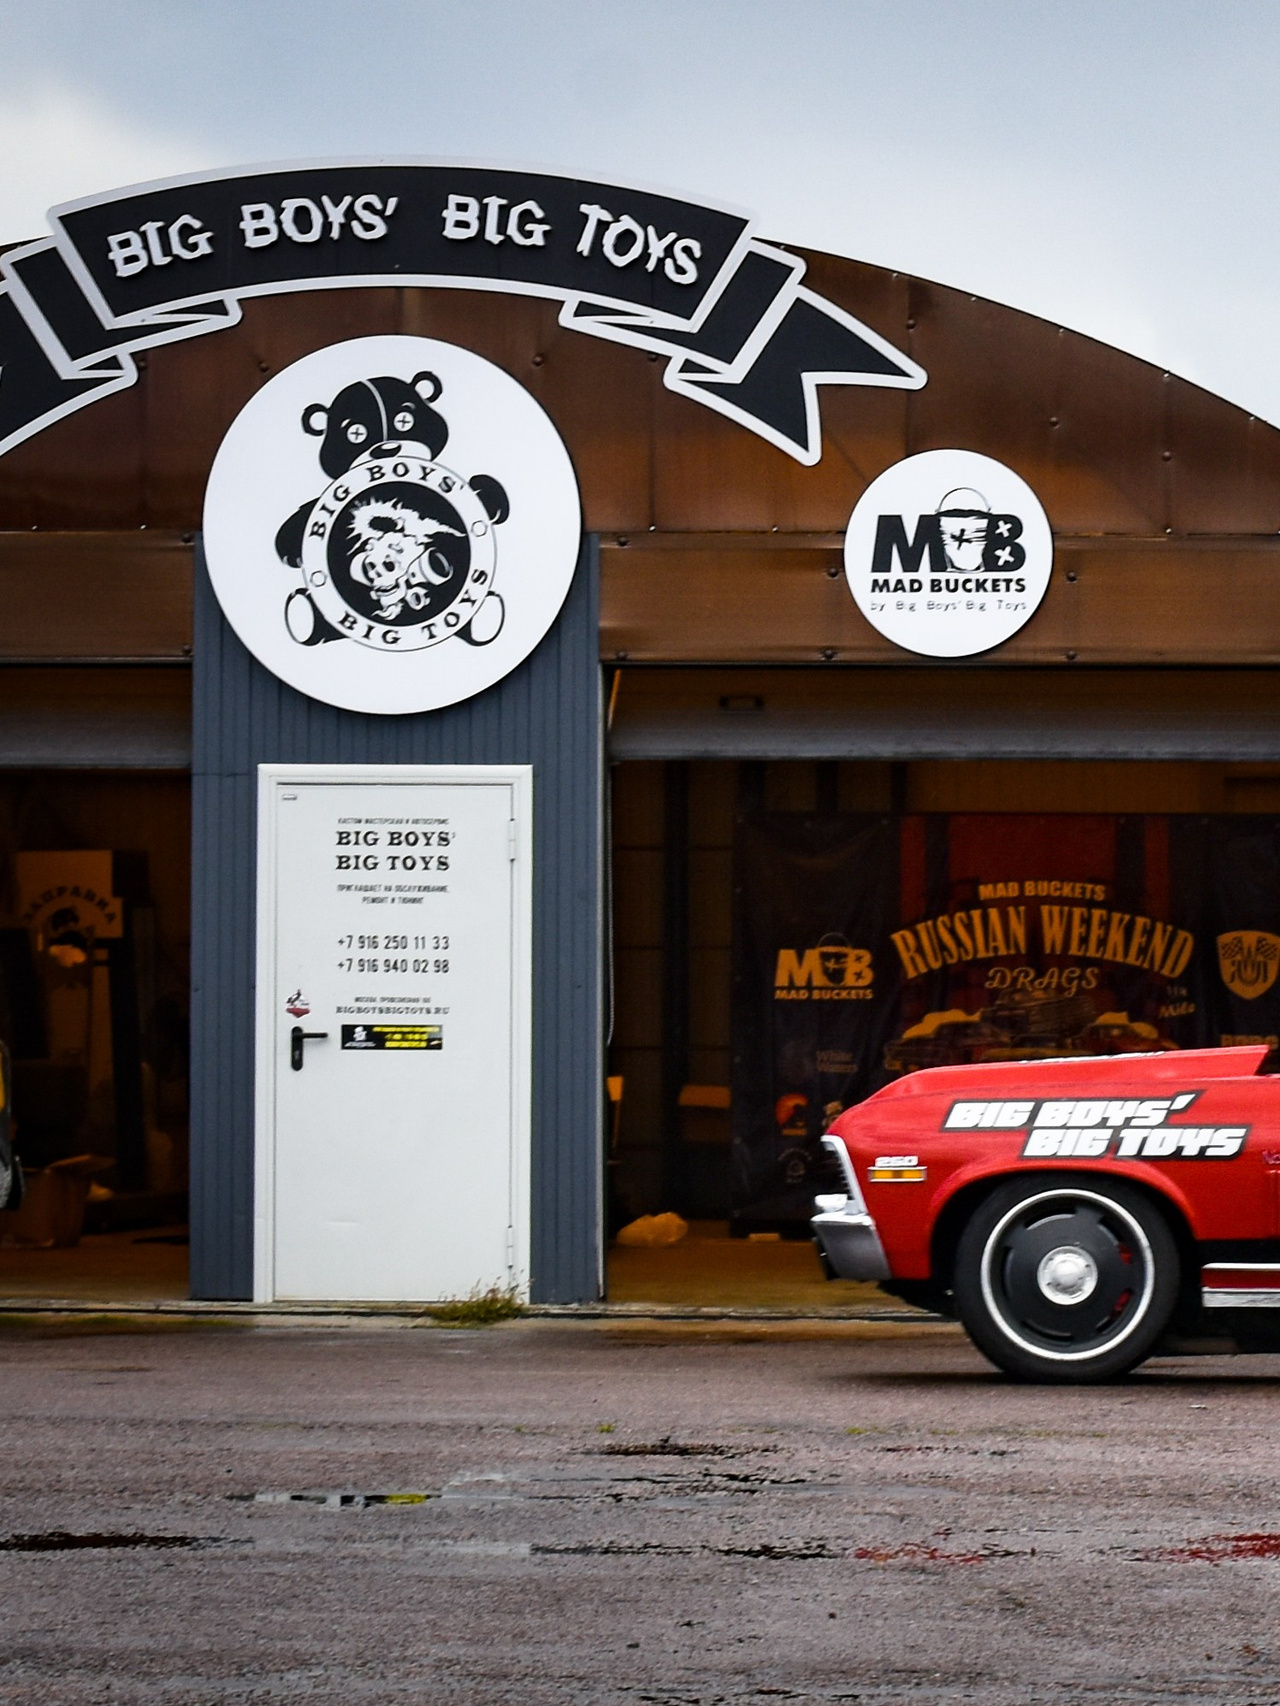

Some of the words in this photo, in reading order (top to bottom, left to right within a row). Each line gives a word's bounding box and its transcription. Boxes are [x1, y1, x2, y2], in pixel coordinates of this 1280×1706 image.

[108, 218, 214, 278] BIG
[240, 196, 398, 250] BOYS'
[443, 193, 551, 247] BIG
[578, 202, 703, 285] TOYS
[310, 484, 351, 540] BIG
[367, 462, 466, 493] BOYS'
[871, 578, 923, 593] MAD
[930, 578, 1026, 593] BUCKETS
[338, 610, 400, 645] BIG
[421, 568, 488, 640] TOYS
[870, 600, 885, 612] by
[896, 600, 916, 612] Big
[966, 600, 986, 611] Big
[997, 599, 1027, 612] Toys
[336, 831, 380, 847] BIG
[387, 831, 456, 847] BOYS'
[336, 855, 380, 871] BIG
[387, 855, 450, 871] TOYS
[977, 881, 1018, 901] MAD
[1024, 879, 1106, 902] BUCKETS
[338, 935, 354, 949] +7
[358, 935, 379, 950] 916
[384, 935, 408, 950] 250
[414, 936, 426, 950] 11
[432, 936, 449, 950] 33
[891, 905, 1027, 980] RUSSIAN
[1040, 904, 1195, 980] WEEKEND
[338, 958, 354, 973] +7
[358, 958, 379, 973] 916
[383, 958, 408, 973] 940
[412, 959, 429, 973] 02
[434, 959, 449, 973] 98
[985, 966, 1099, 998] DRAGS
[774, 989, 809, 1000] MAD
[811, 989, 875, 1000] BUCKETS
[945, 1101, 1032, 1128] BIG
[1032, 1094, 1196, 1128] BOYS'
[1024, 1128, 1113, 1157] BIG
[1115, 1128, 1247, 1157] TOYS
